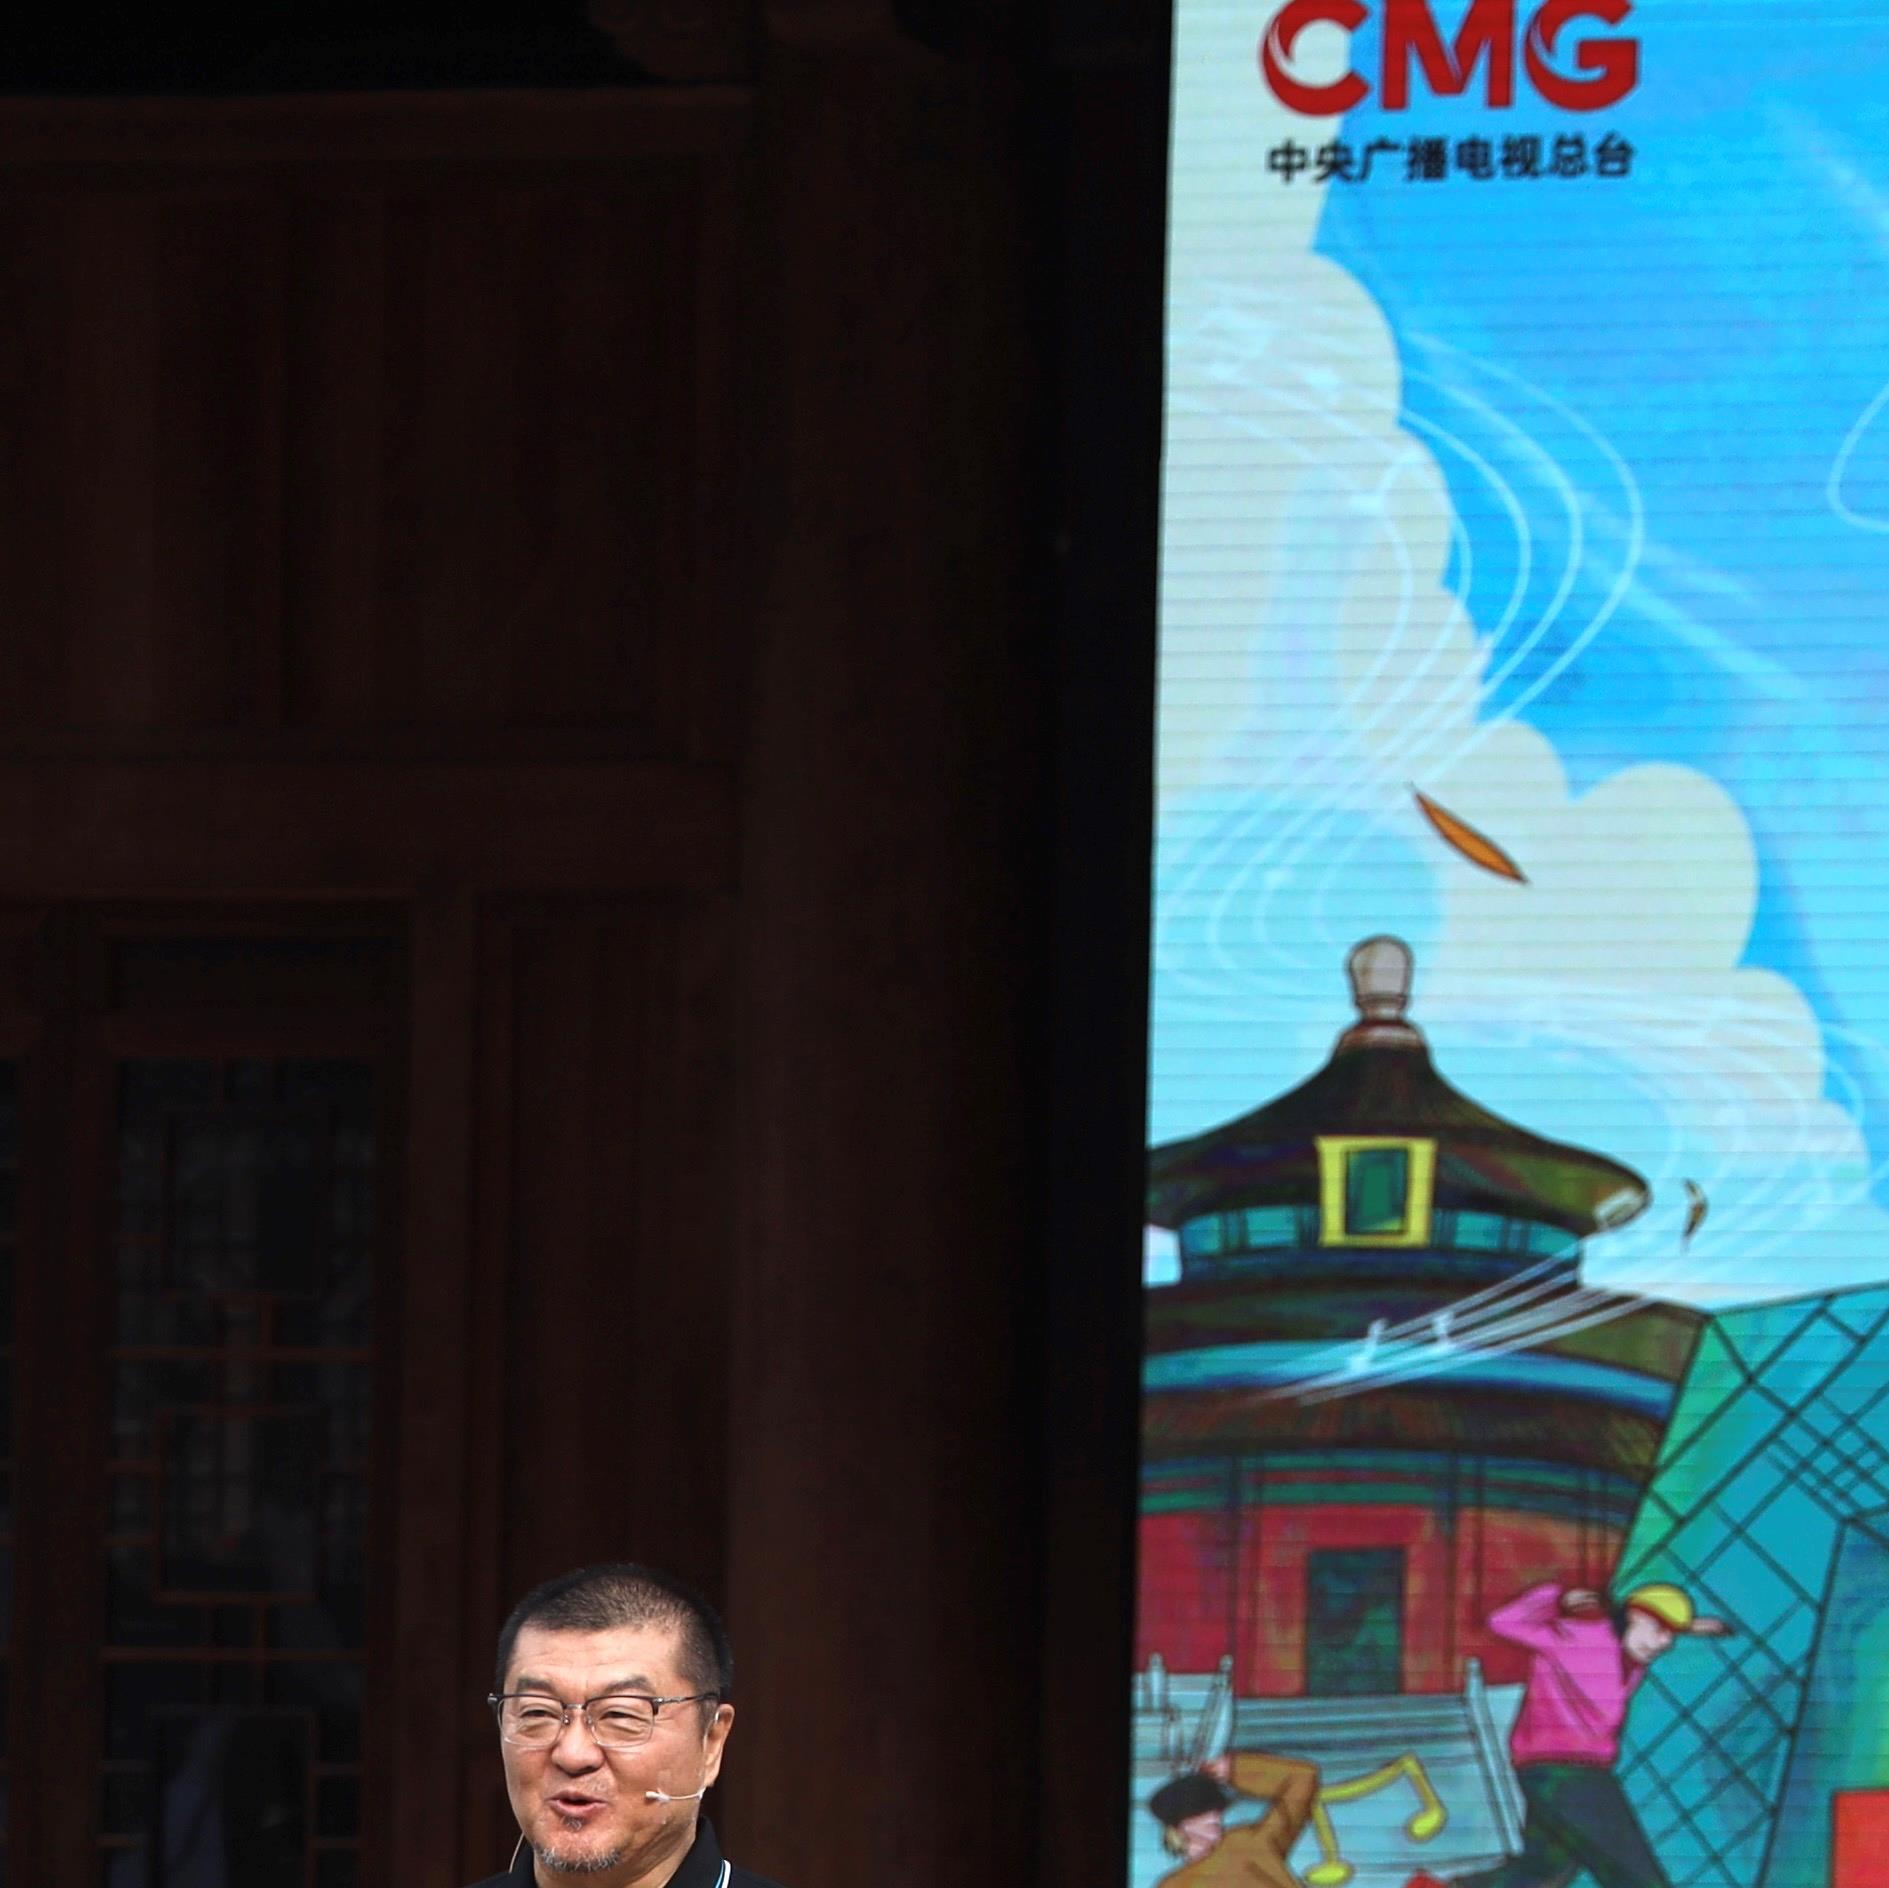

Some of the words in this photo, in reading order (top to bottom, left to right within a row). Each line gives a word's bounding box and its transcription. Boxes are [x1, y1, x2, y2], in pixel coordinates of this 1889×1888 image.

[1261, 0, 1639, 117] CMG
[1268, 132, 1635, 184] 中央广播电视总台
